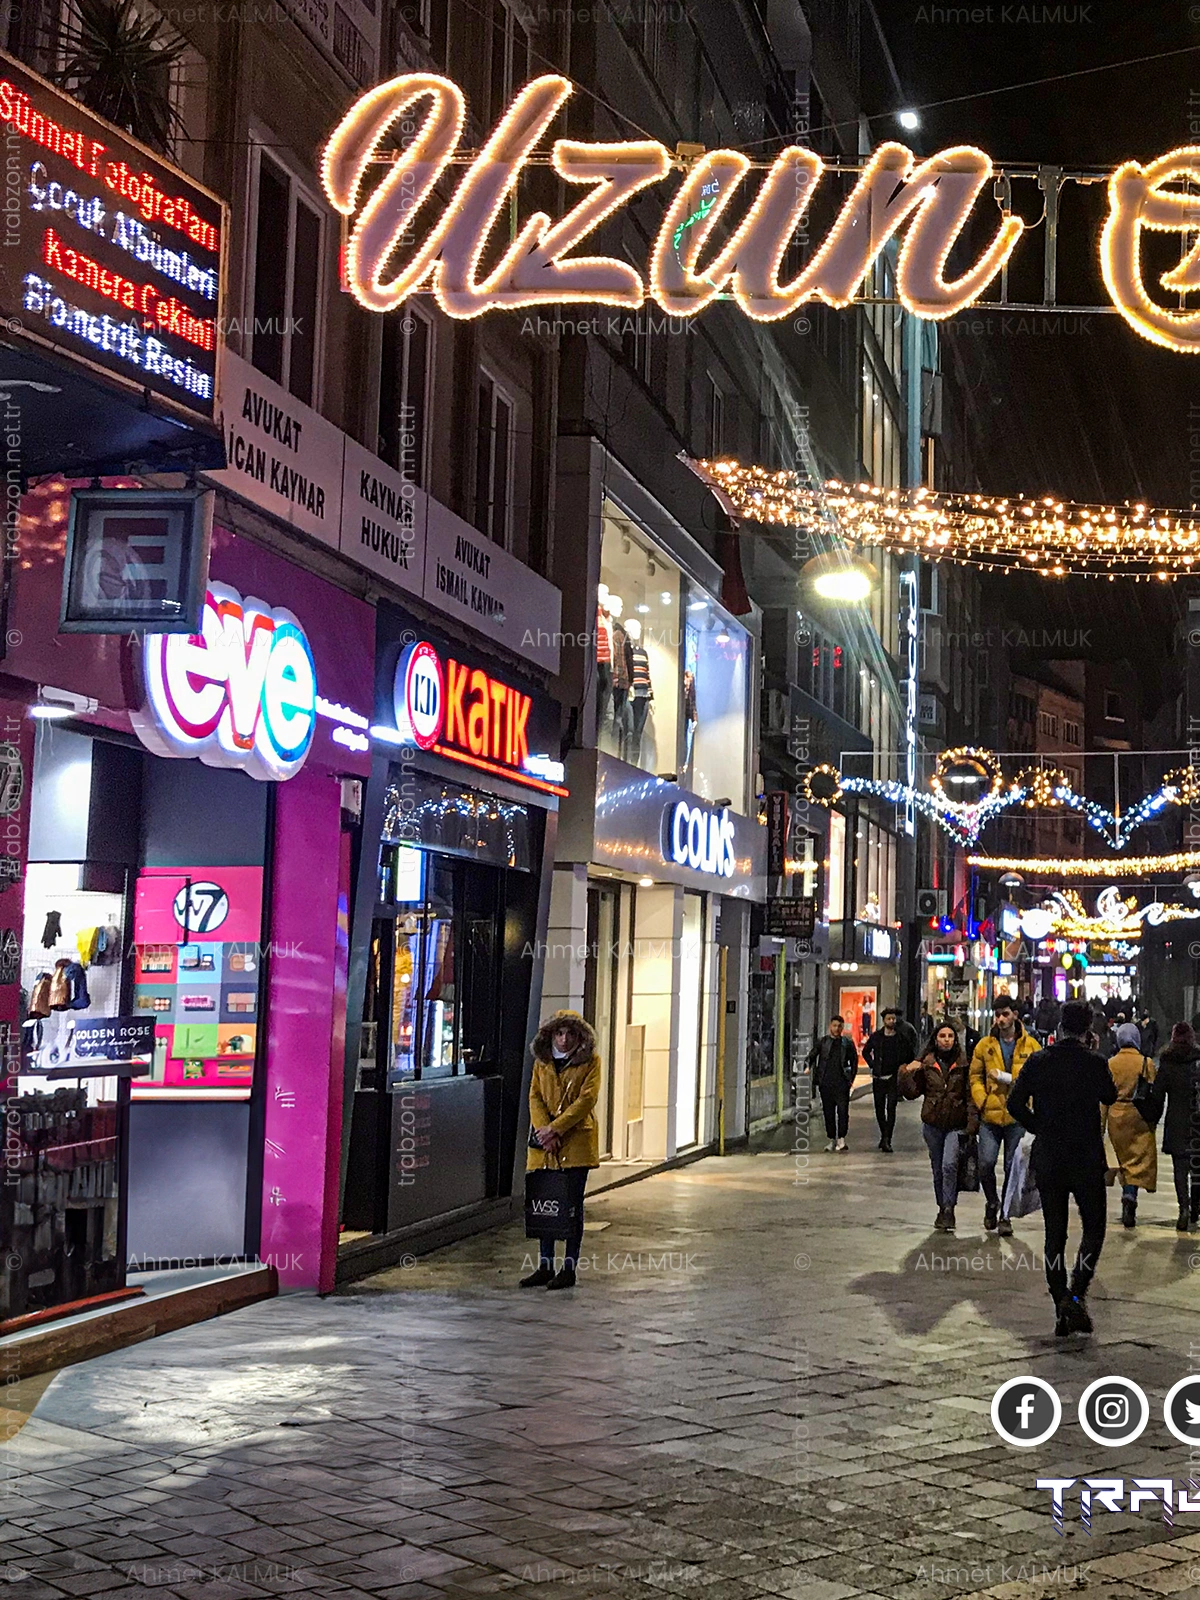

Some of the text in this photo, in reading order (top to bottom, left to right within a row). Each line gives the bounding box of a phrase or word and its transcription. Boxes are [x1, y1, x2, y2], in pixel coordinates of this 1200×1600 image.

[320, 73, 1025, 320] Uzun
[242, 388, 303, 453] AVUKAT
[269, 456, 326, 520] KAYNAR
[360, 516, 410, 570] HUKUK
[454, 535, 491, 580] AVUKAT
[436, 557, 469, 606] İSMAİL
[157, 588, 318, 763] eve
[120, 1026, 150, 1037] ROSE
[532, 1199, 559, 1213] WSS
